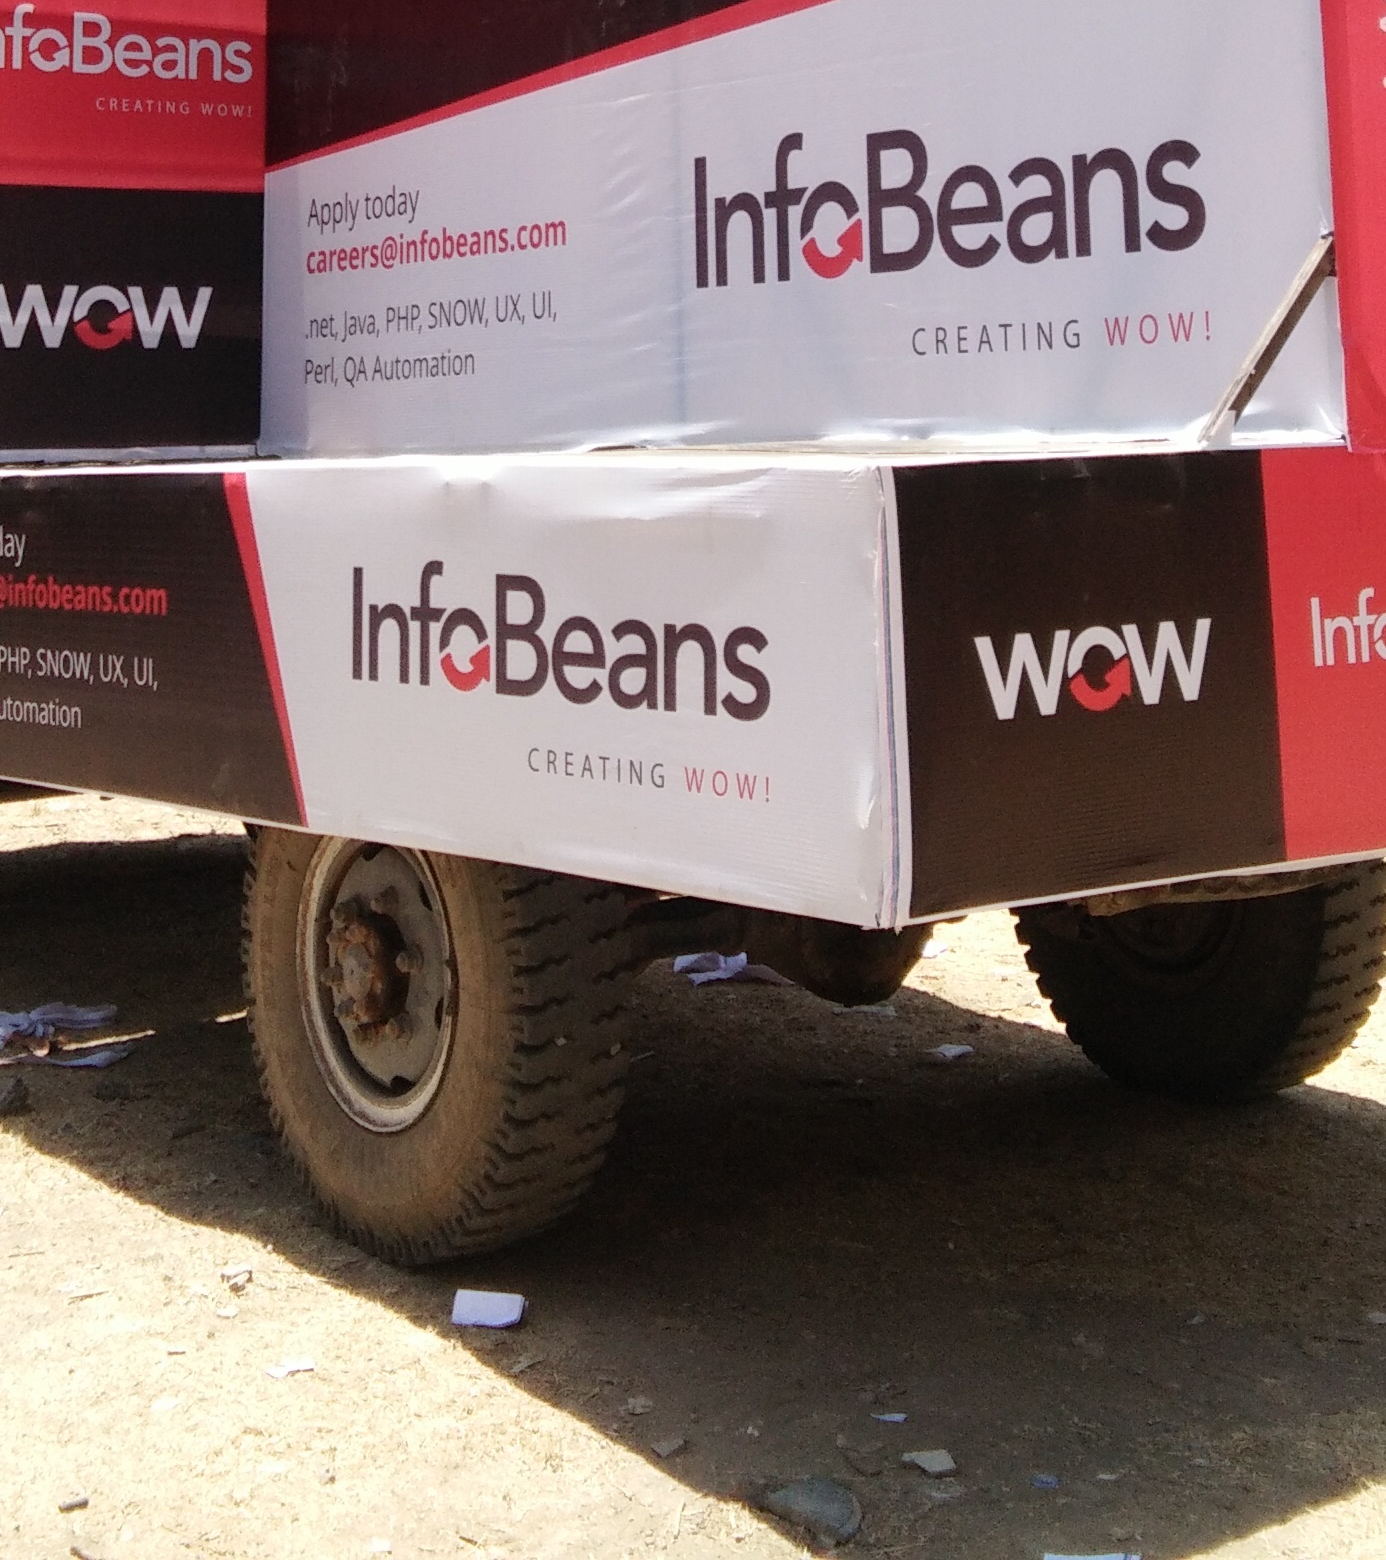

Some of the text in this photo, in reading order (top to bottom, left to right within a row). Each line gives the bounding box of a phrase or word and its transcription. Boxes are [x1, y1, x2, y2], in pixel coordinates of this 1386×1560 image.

[96, 96, 253, 119] CREATING WOW!
[307, 185, 420, 235] Apply today
[694, 128, 1207, 290] InfoBeans
[306, 220, 567, 275] careers@infobeans.com
[305, 290, 557, 343] .net, Java, PHP, SNOW, UX, UI,
[911, 310, 1213, 357] CREATING WOW!
[304, 349, 475, 388] Perl, QA Automation
[351, 560, 769, 722] InfoBeans
[36, 648, 94, 685] SNOW,
[99, 653, 128, 688] UX,
[134, 656, 158, 691] UI,
[974, 618, 1211, 721] WOW
[527, 746, 771, 804] CREATING WOW!
